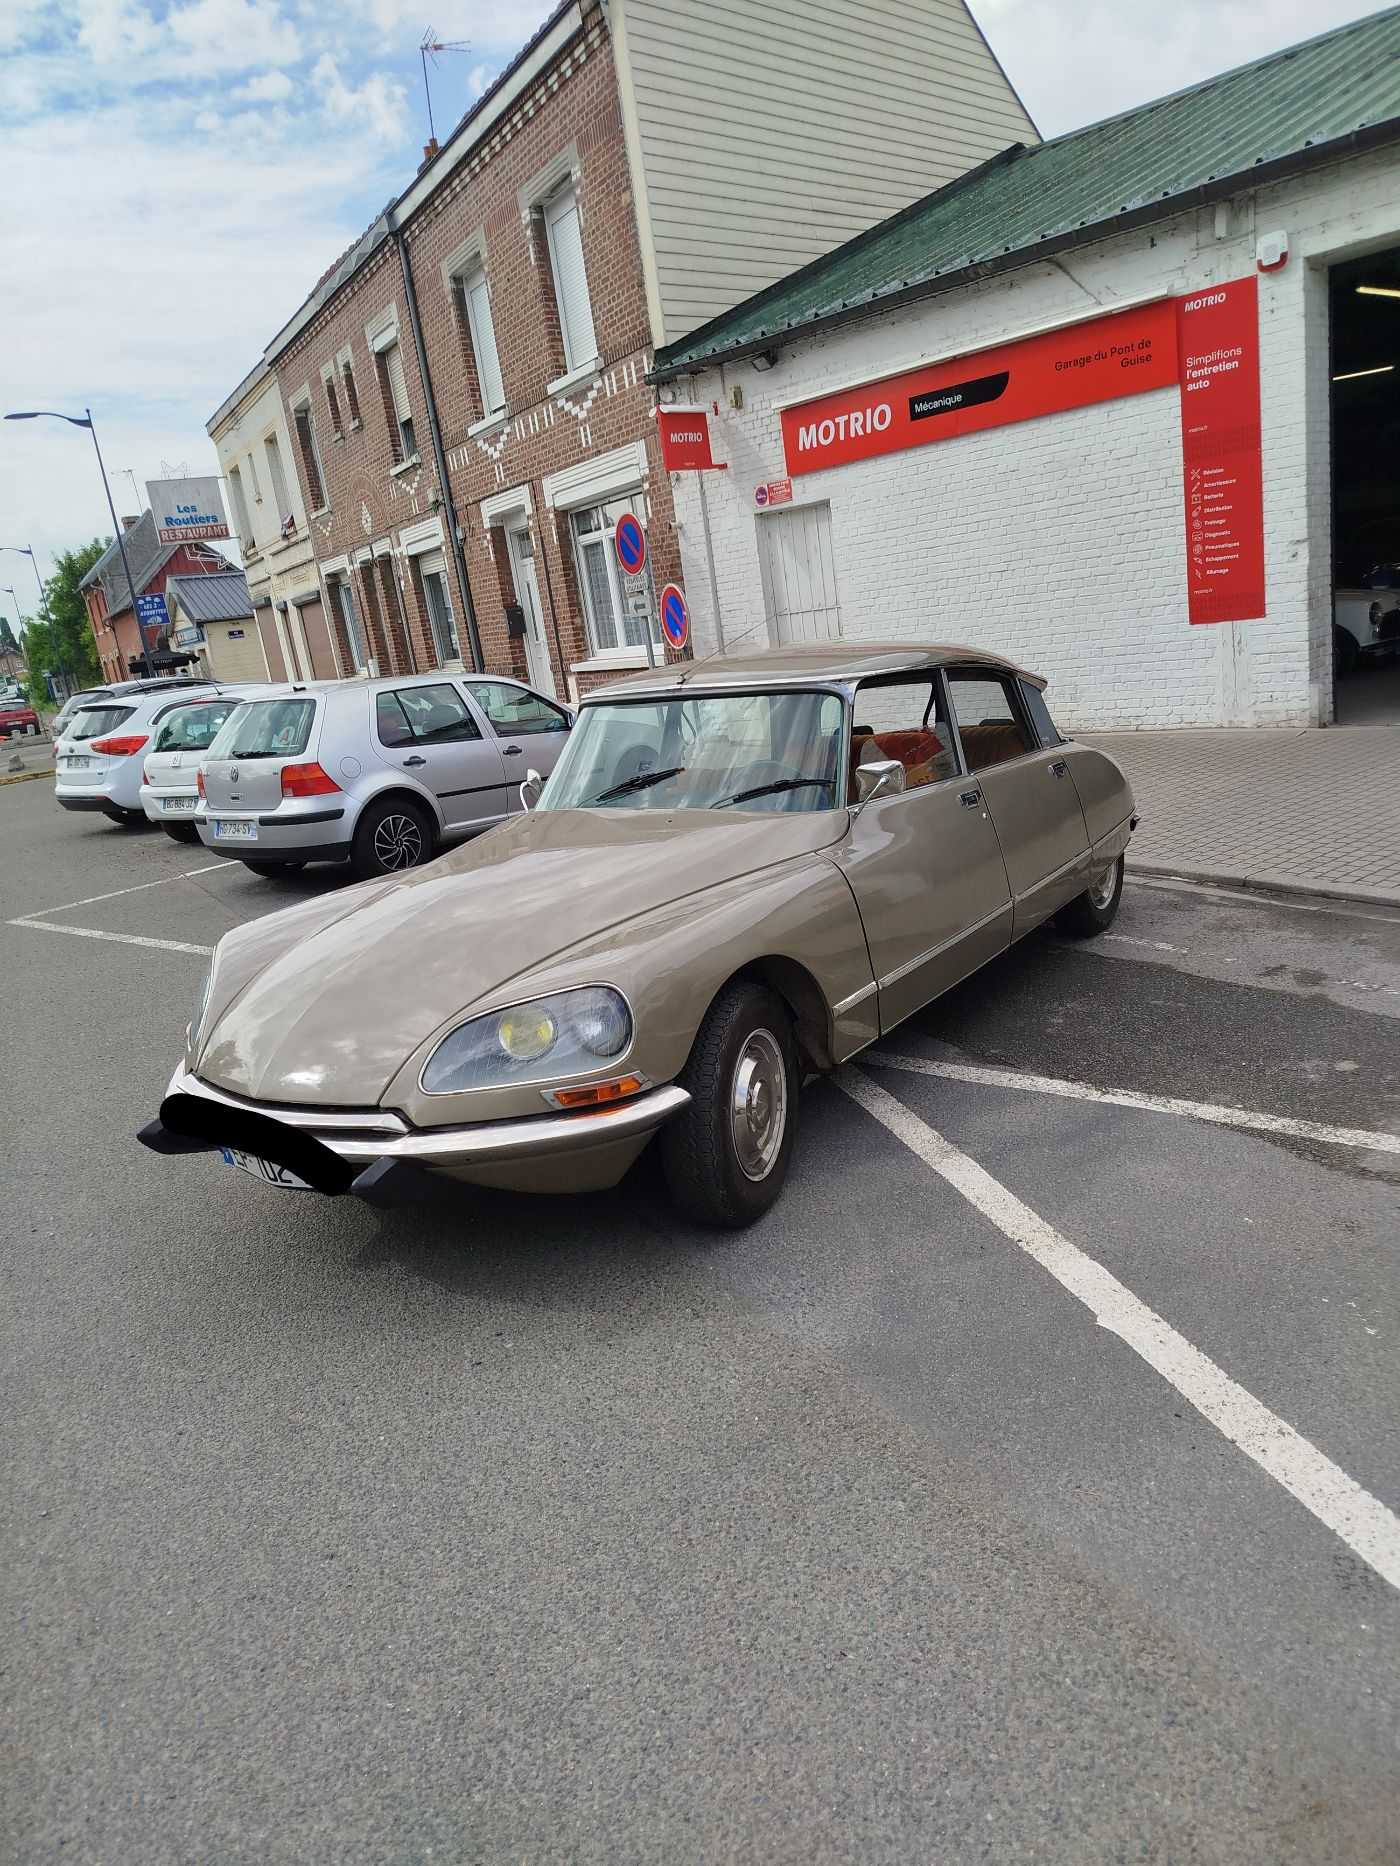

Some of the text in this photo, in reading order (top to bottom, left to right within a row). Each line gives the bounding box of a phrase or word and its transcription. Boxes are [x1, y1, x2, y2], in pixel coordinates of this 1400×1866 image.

[1184, 292, 1227, 312] MOTRIO
[1054, 339, 1152, 371] Garage du Pont de
[1120, 353, 1153, 368] Guise
[1186, 346, 1243, 368] Simplifions
[1186, 361, 1239, 379] l'entretien
[1186, 379, 1210, 392] auto
[798, 393, 963, 451] MOTRIO Mécanique
[670, 431, 703, 443] MOTRIO
[176, 504, 197, 514] Les
[164, 514, 219, 527] Routiers
[161, 525, 228, 541] RESTAURANT
